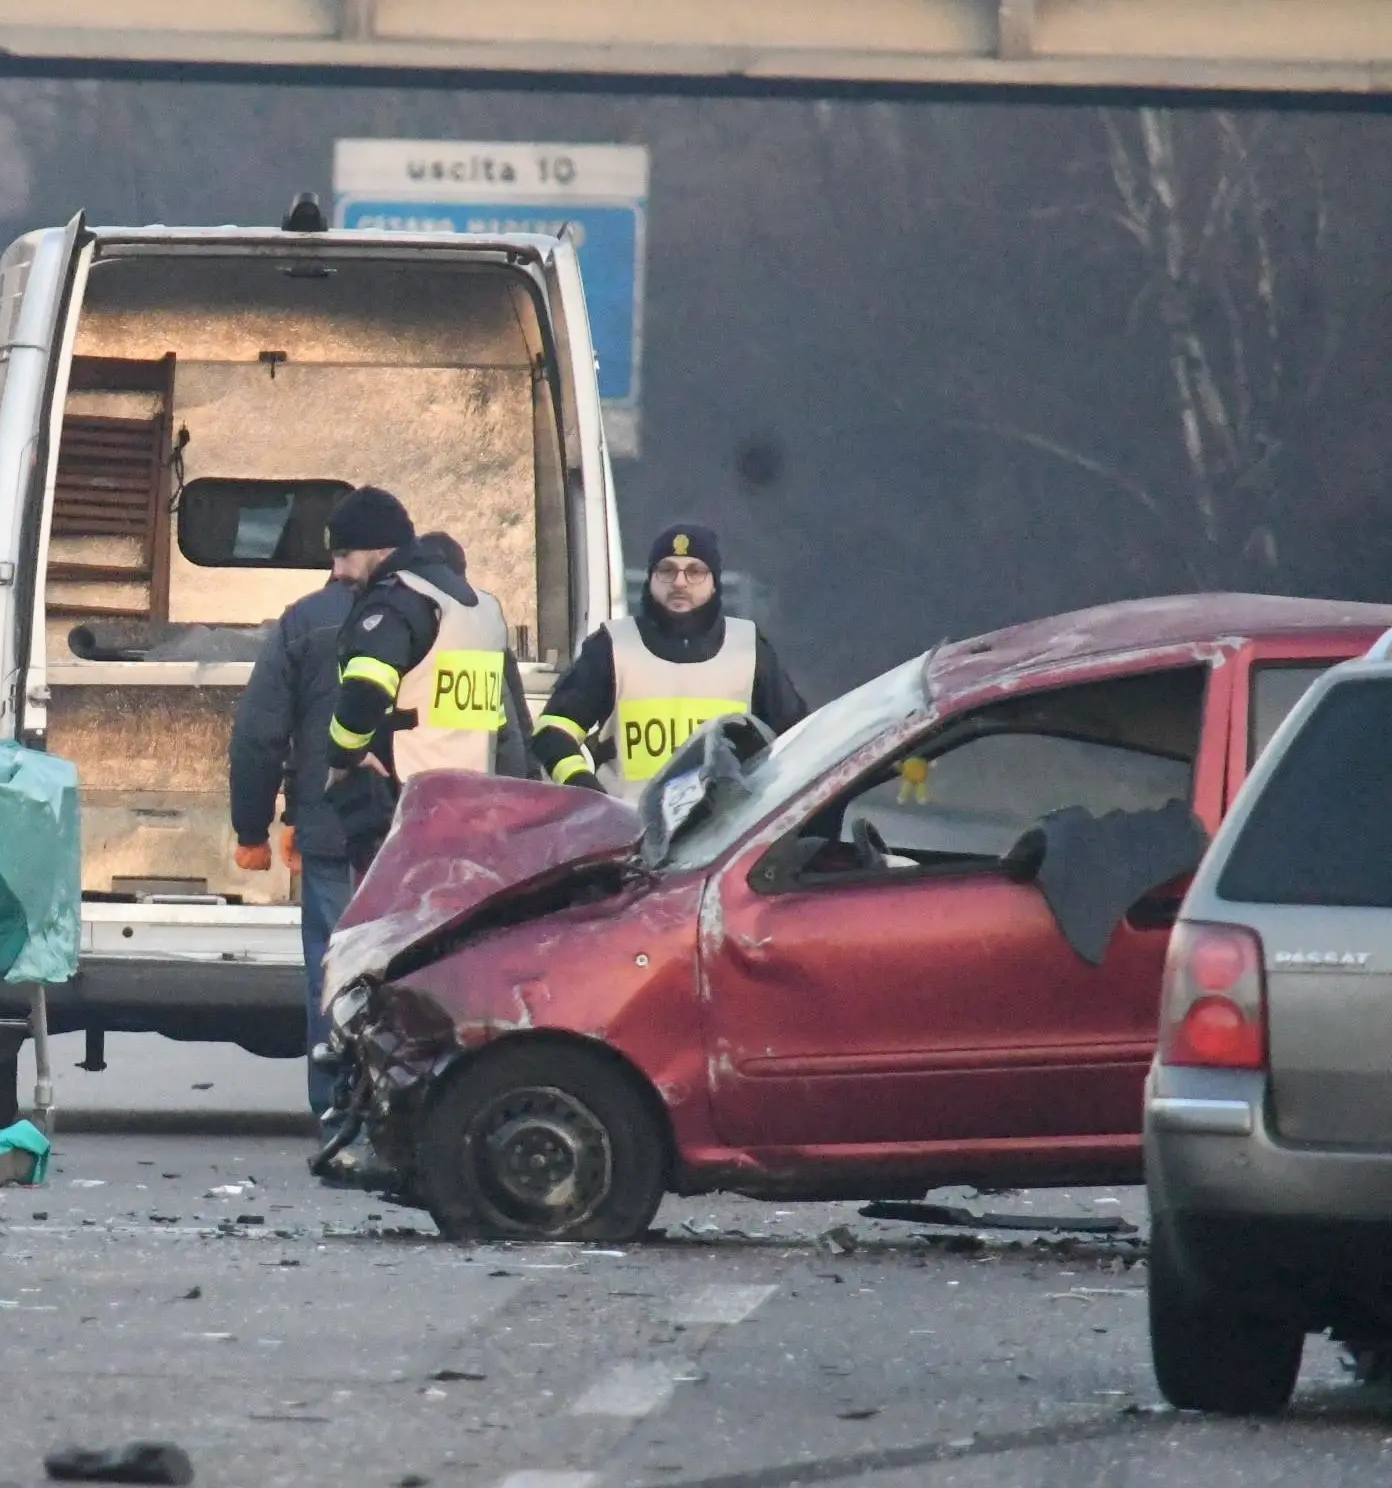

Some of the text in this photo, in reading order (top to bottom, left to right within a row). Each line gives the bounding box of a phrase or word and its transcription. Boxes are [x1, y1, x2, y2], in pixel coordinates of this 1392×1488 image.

[406, 155, 577, 185] uscita 10
[625, 717, 709, 760] POL
[1275, 950, 1371, 964] PASSAT
